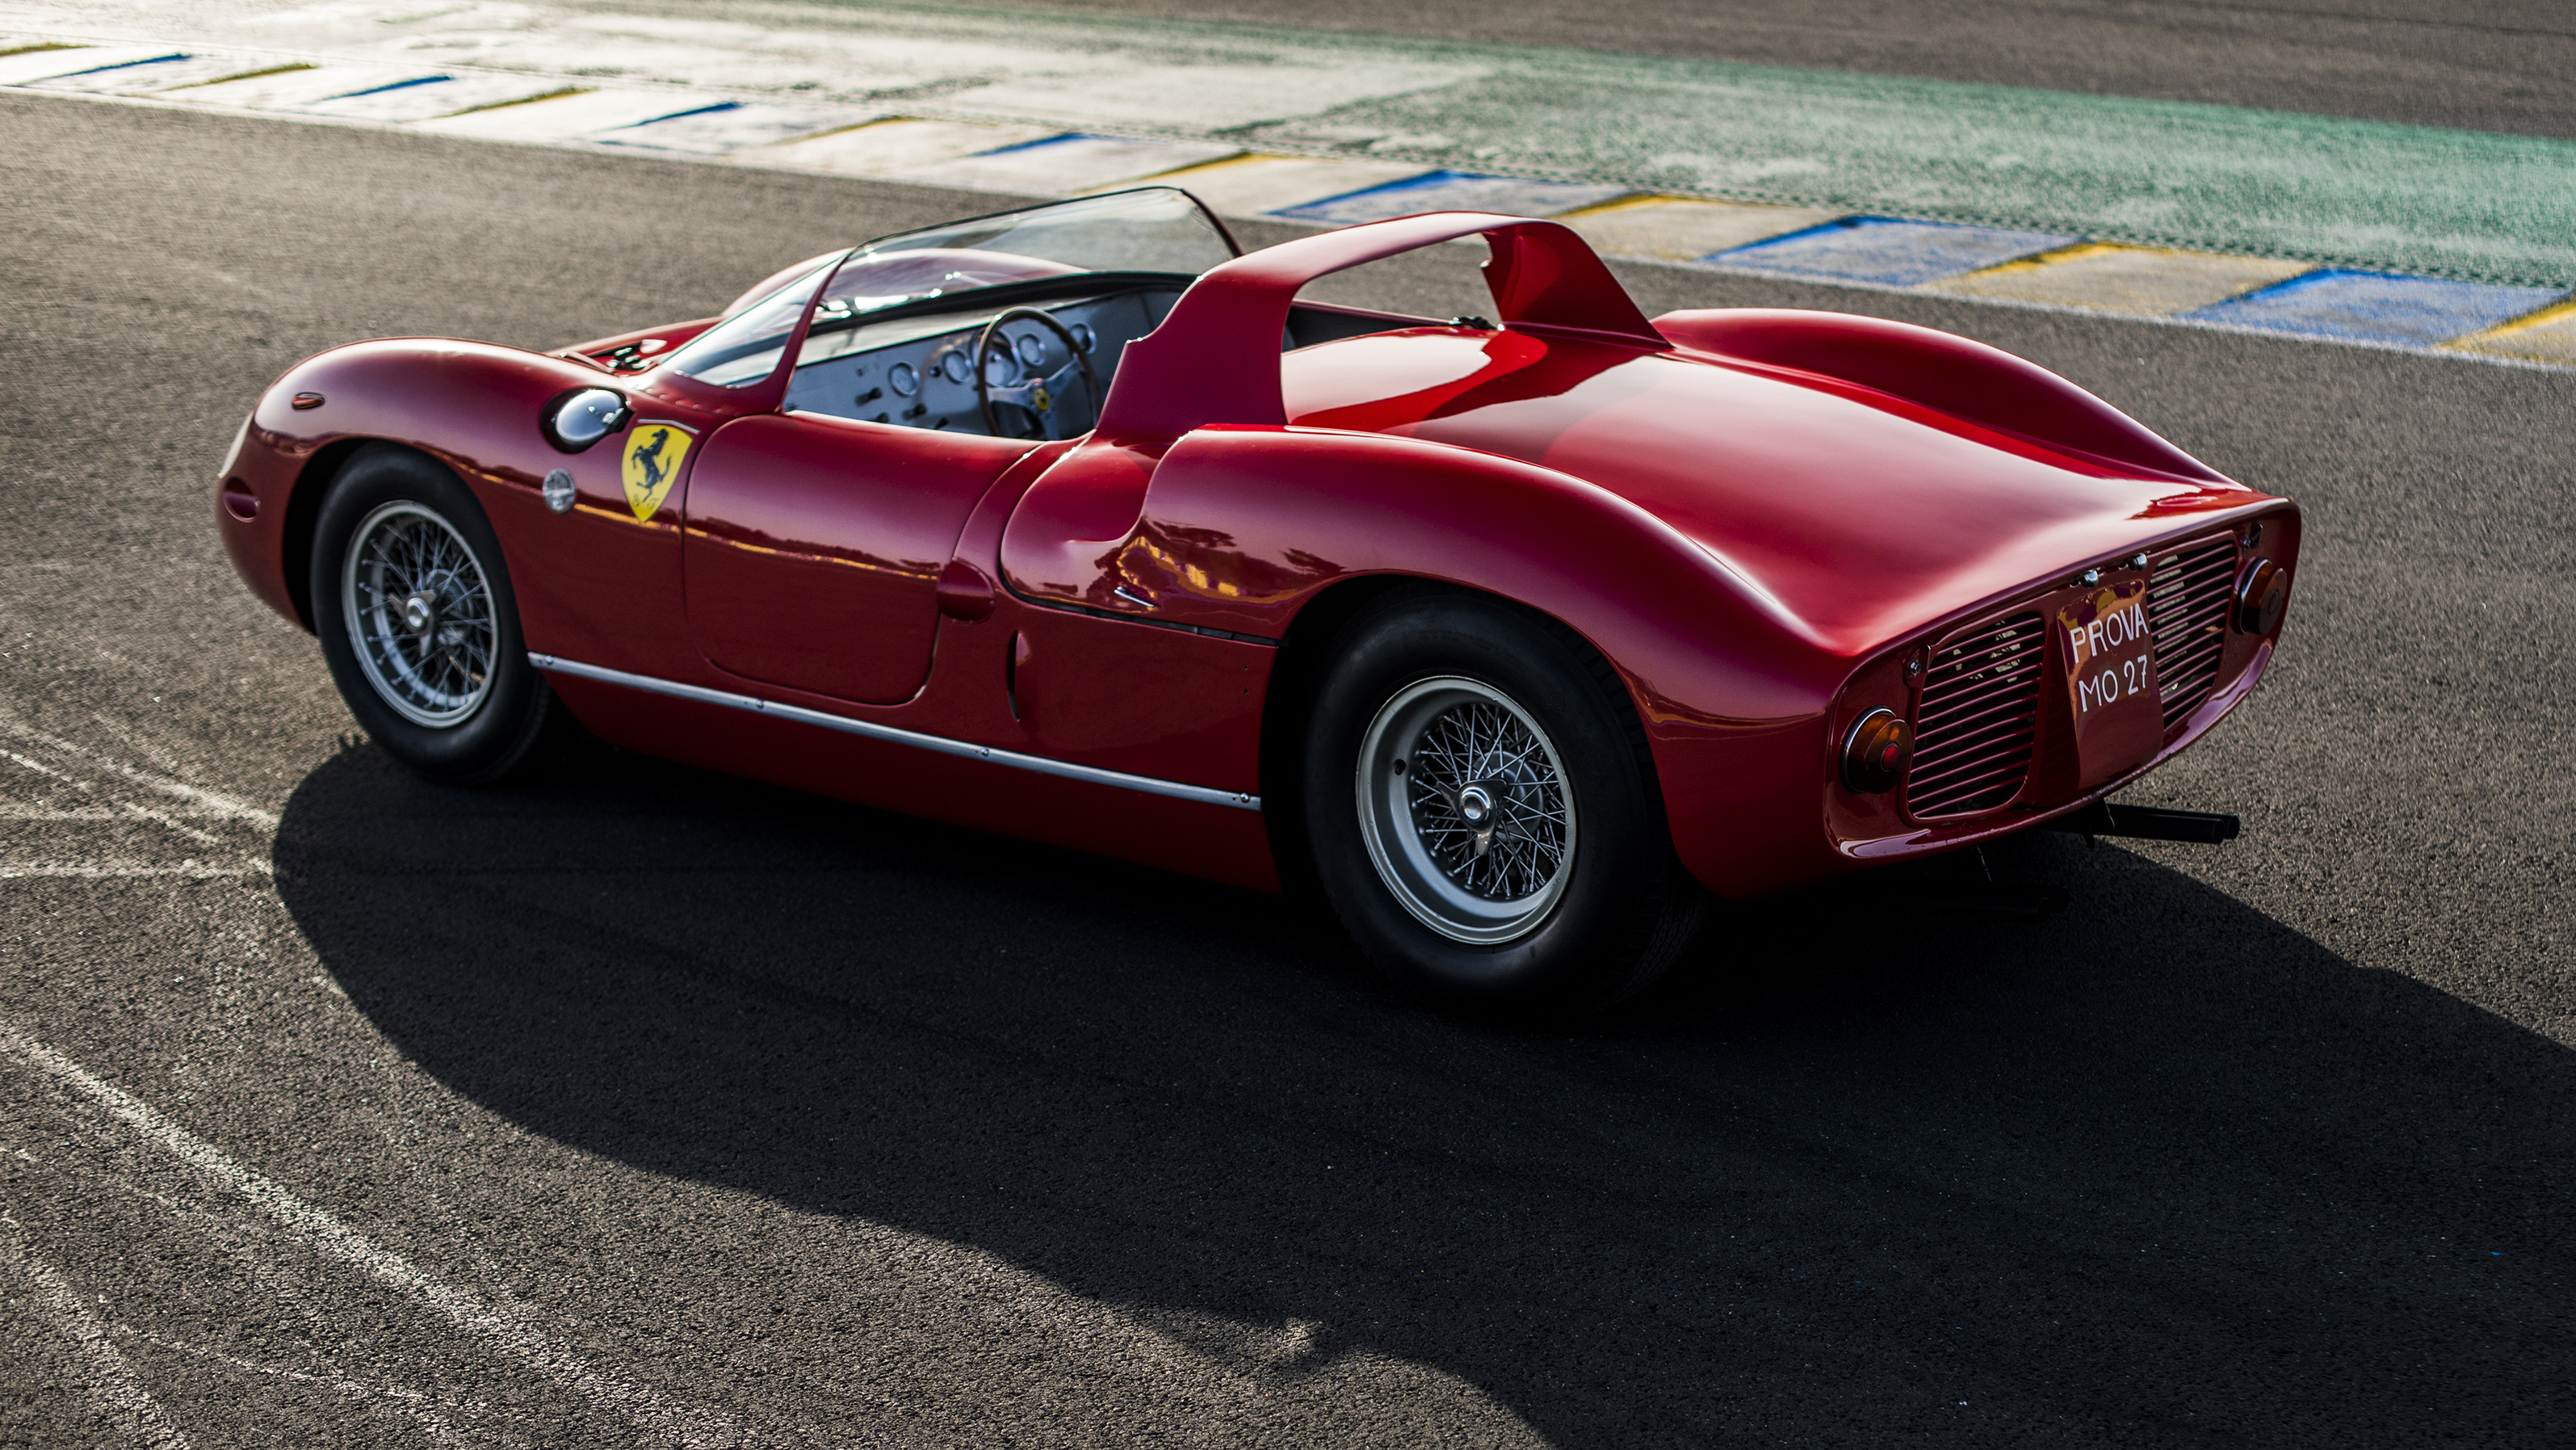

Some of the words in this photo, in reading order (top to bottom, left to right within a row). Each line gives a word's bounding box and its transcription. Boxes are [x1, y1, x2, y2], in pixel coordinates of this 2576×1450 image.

[2070, 603, 2149, 664] PROVA
[2079, 670, 2118, 712] MO
[2124, 654, 2147, 696] 27
